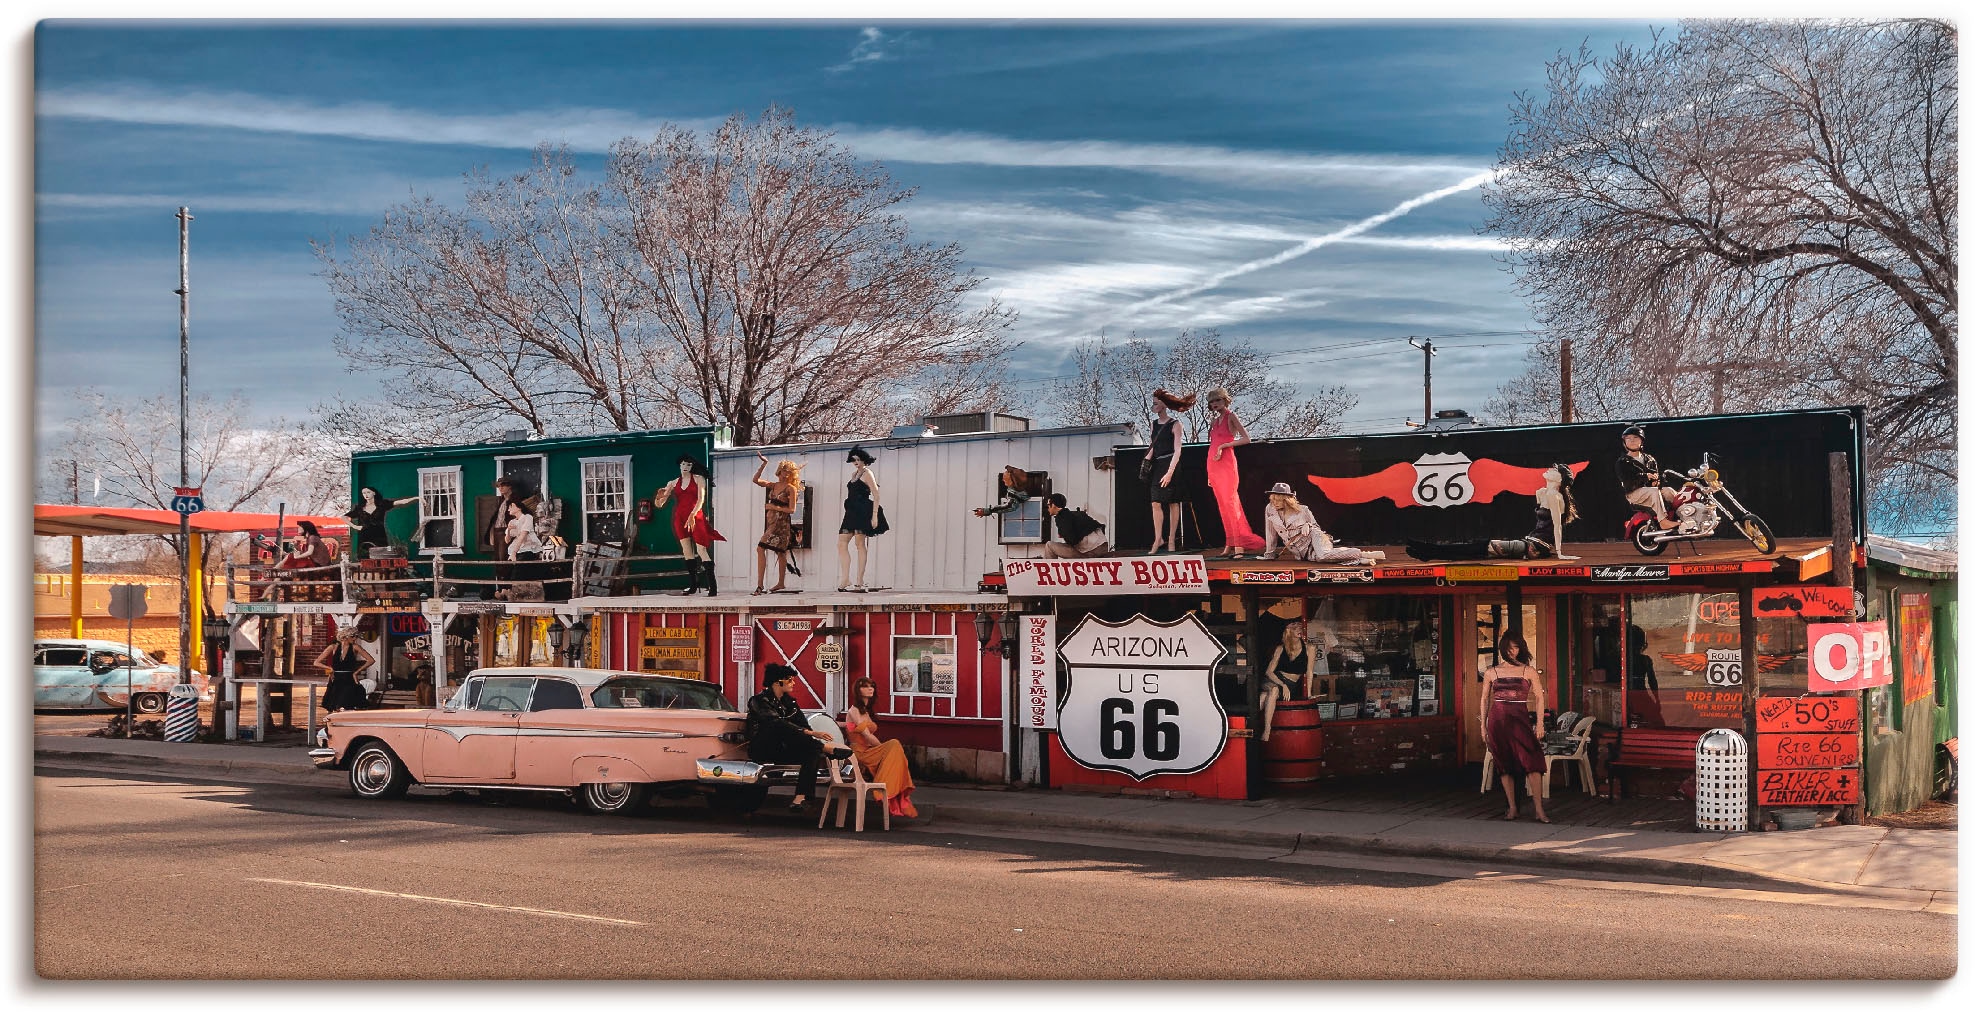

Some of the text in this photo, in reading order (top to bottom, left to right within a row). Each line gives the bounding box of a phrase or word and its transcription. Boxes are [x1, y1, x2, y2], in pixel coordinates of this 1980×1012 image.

[1418, 472, 1466, 502] 66
[176, 498, 199, 512] 66
[1006, 560, 1203, 586] The RUSTY BOLT
[1531, 567, 1583, 575] LADY BIKER
[1598, 566, 1666, 580] Marilyn Monroe
[1800, 588, 1853, 615] WELCOME
[1700, 602, 1741, 620] OPE
[391, 615, 428, 633] OPEN
[649, 630, 693, 638] LEMON CAB CO
[1029, 617, 1047, 665] WORLD
[1681, 632, 1712, 644] LIVE
[1716, 632, 1733, 644] TO
[404, 634, 432, 653] RUST
[673, 648, 698, 657] ARIZONA
[1090, 637, 1189, 658] ARIZONA
[821, 660, 839, 669] 66
[1711, 652, 1740, 661] ROUTE
[1813, 630, 1893, 682] OPE
[1709, 663, 1742, 684] 66
[1029, 670, 1047, 727] FAMOUS
[1686, 691, 1742, 702] RIDE ROUT
[1760, 698, 1793, 722] NEATO
[1100, 697, 1181, 761] 66
[1825, 719, 1857, 731] STUFF
[1818, 736, 1842, 753] 66
[1775, 753, 1854, 767] SOUVENIRS
[1761, 771, 1831, 792] BIKER
